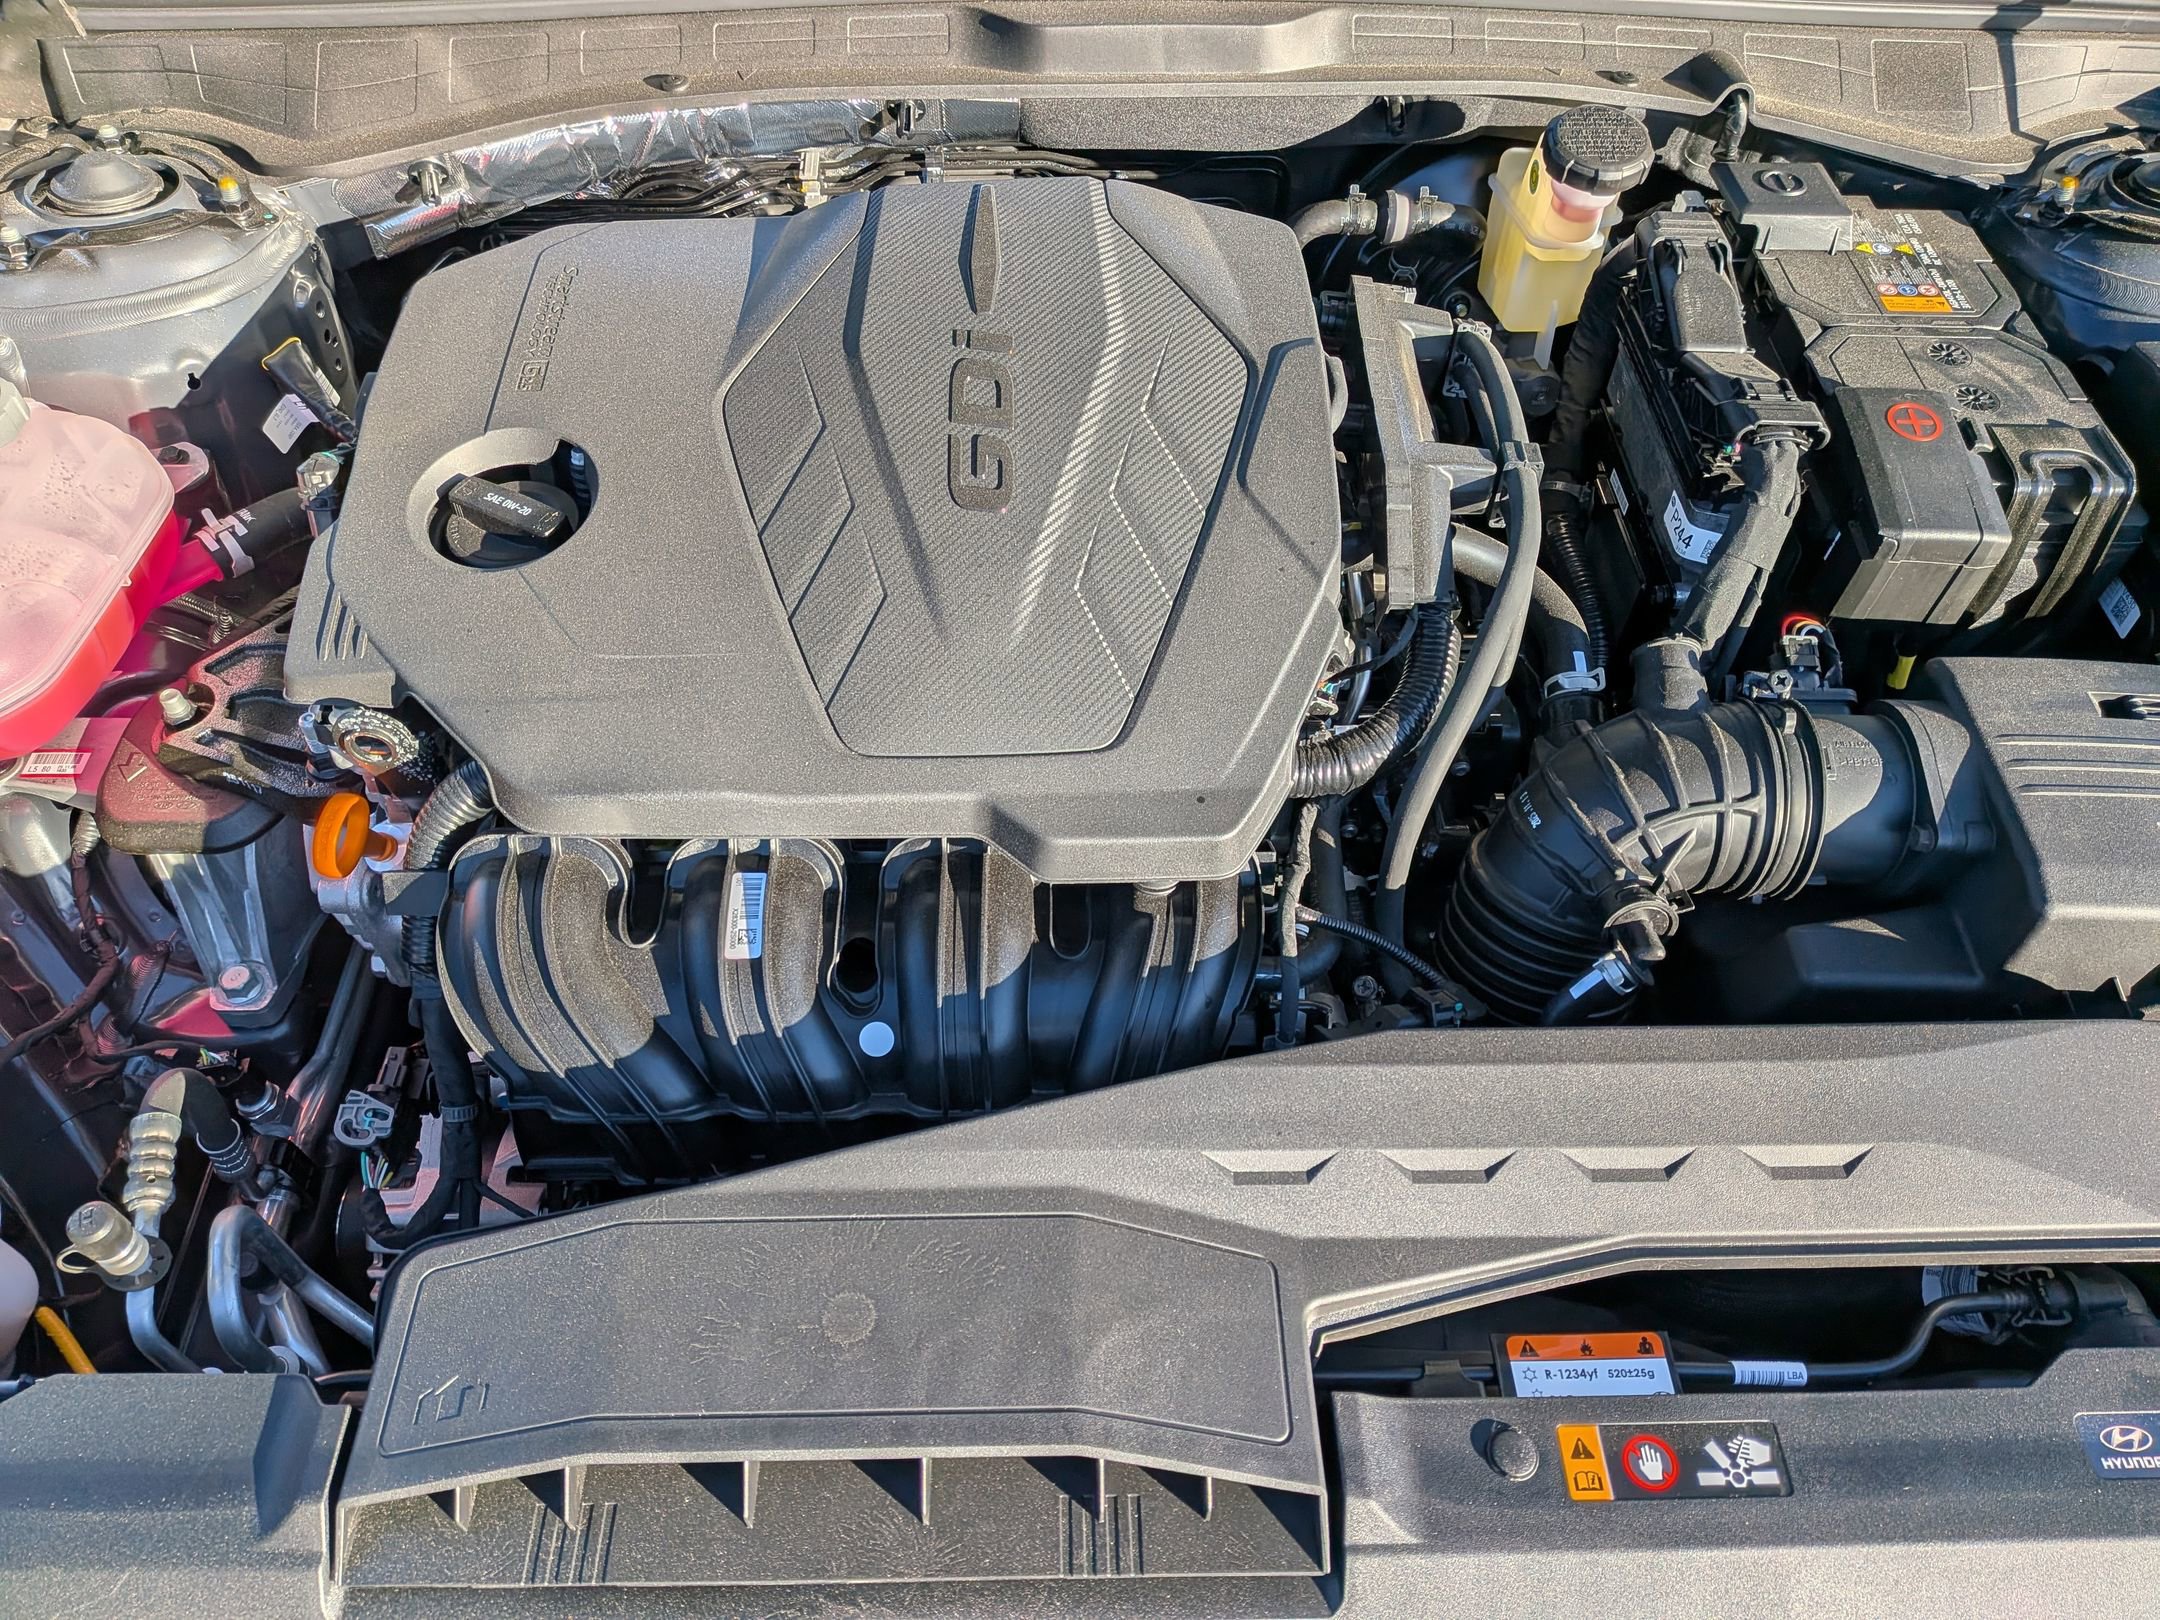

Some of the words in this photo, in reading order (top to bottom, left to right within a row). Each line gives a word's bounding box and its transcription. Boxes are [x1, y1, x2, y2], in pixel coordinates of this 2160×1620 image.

[483, 491, 504, 506] SAE
[501, 499, 533, 517] 0W-20
[1670, 507, 1694, 550] P244
[1544, 1368, 1598, 1382] R-1234yf
[1607, 1367, 1655, 1380] 520±25g
[1786, 1371, 1805, 1381] LBA
